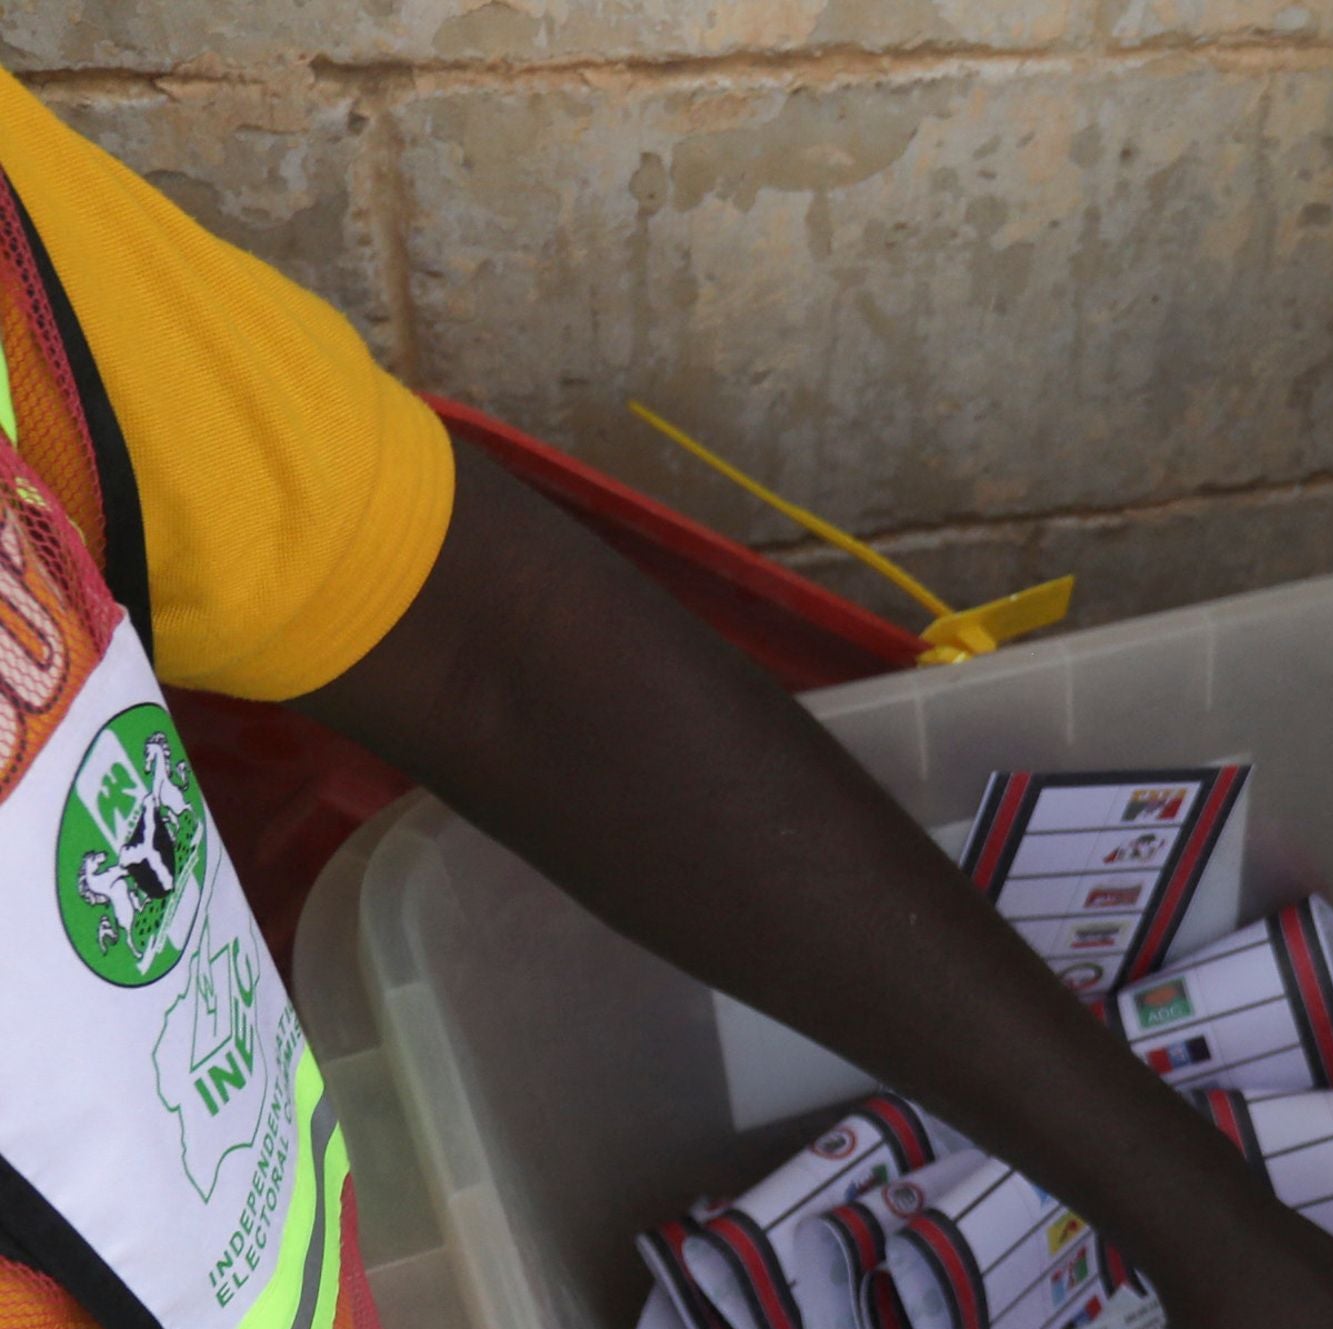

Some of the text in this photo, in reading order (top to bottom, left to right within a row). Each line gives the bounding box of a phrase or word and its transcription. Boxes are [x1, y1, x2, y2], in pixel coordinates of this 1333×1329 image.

[192, 936, 260, 1117] INEC
[1148, 1004, 1180, 1023] ADC
[209, 1080, 285, 1287] INDEPENDENT
[215, 1137, 289, 1308] ELECTORAL
